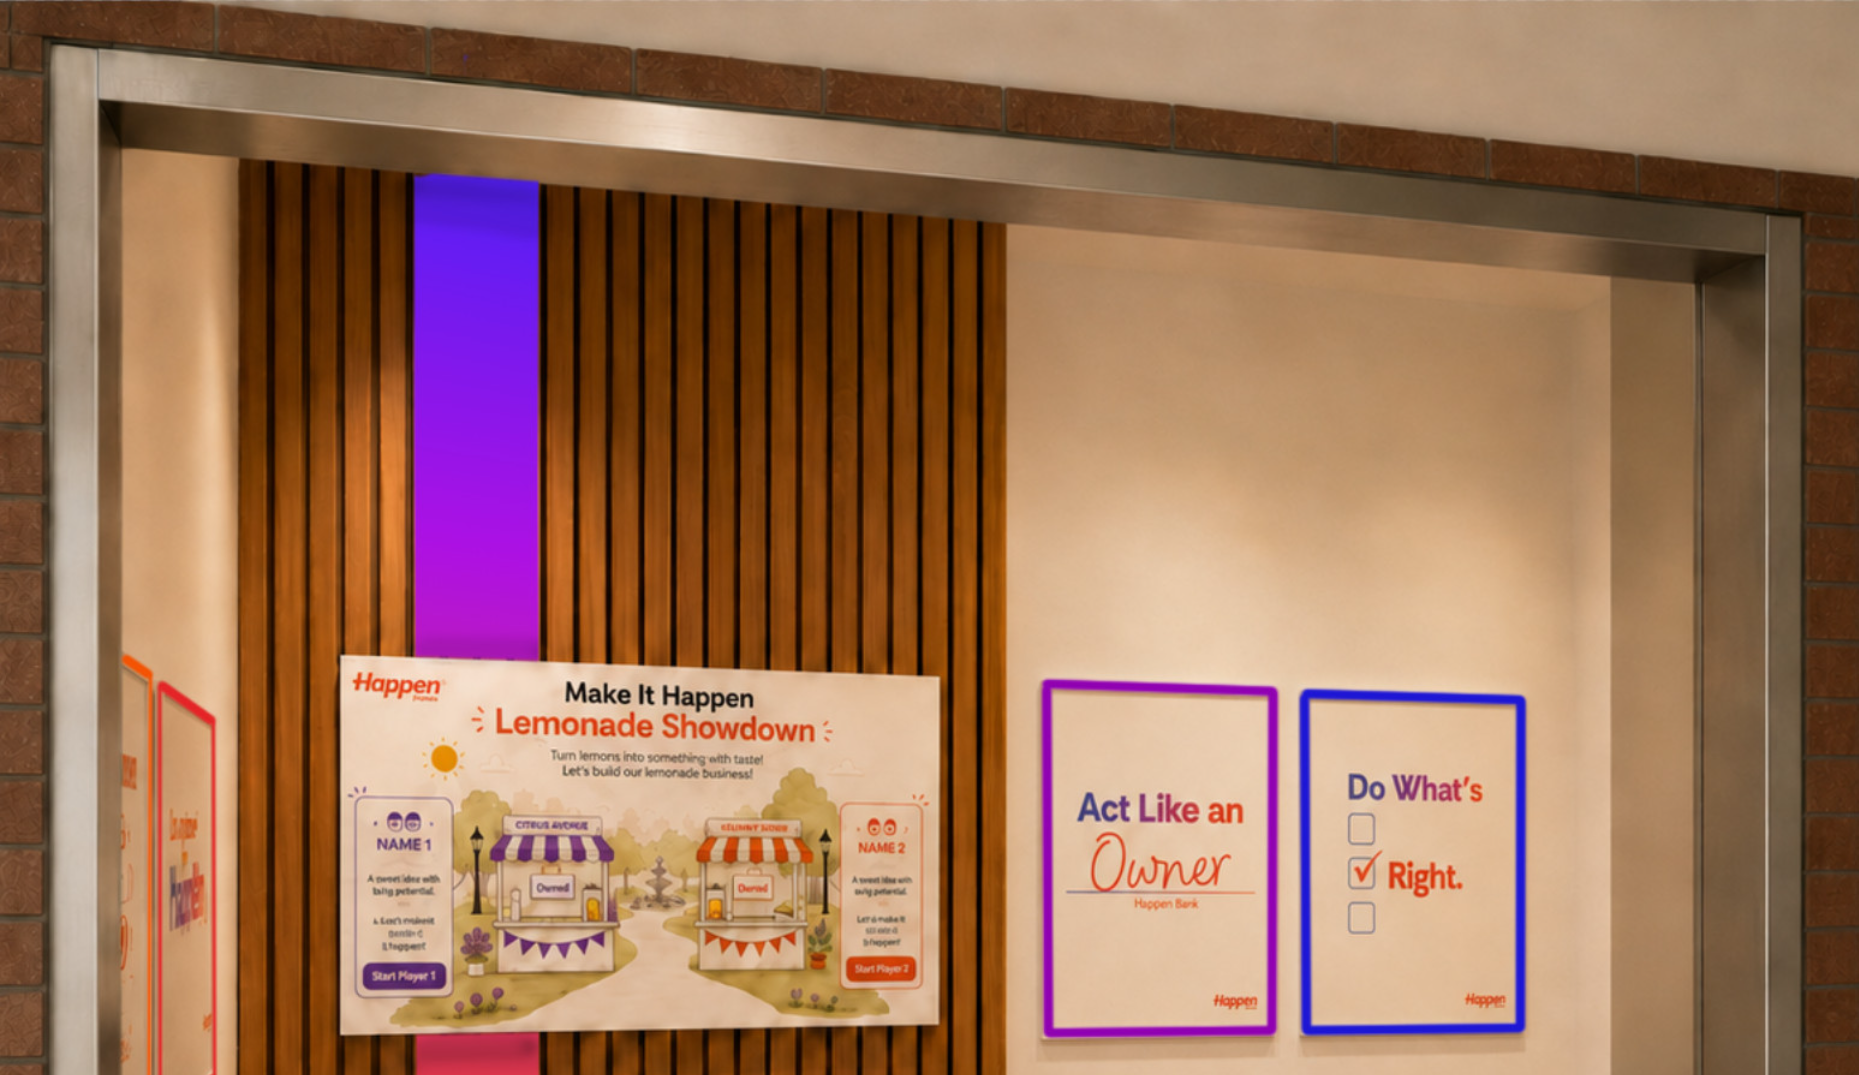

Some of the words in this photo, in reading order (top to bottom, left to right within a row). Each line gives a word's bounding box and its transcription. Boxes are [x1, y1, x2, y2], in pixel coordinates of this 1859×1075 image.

[352, 672, 441, 699] Happen
[565, 681, 631, 705] Make
[639, 684, 654, 705] It
[663, 685, 754, 712] Happen
[496, 707, 653, 738] Lemonade
[662, 713, 815, 742] Showdown
[551, 750, 576, 761] Turn
[579, 750, 621, 762] lemons
[623, 751, 644, 762] into
[648, 752, 705, 767] something
[709, 753, 731, 764] with
[734, 754, 764, 765] taste!
[562, 765, 590, 777] Let's
[592, 766, 621, 777] build
[623, 768, 642, 777] our
[645, 767, 700, 778] lemonade
[702, 768, 754, 780] business!
[1348, 773, 1386, 801] Do
[1392, 773, 1483, 802] What's
[1077, 792, 1130, 823] Act
[1139, 794, 1200, 824] Like
[1208, 801, 1244, 824] an
[377, 838, 422, 851] NAME
[425, 838, 431, 851] 1
[858, 842, 895, 854] NAME
[898, 842, 906, 854] 2
[1091, 832, 1232, 892] Owner
[1387, 861, 1463, 898] Right.
[1134, 899, 1173, 911] Happen
[1175, 899, 1199, 909] Bank
[372, 971, 396, 981] Start
[398, 971, 428, 983] Player
[431, 971, 436, 980] 1
[855, 964, 875, 974] Start
[876, 964, 902, 976] Player
[1213, 994, 1258, 1009] Happen
[1465, 993, 1506, 1008] Happen
